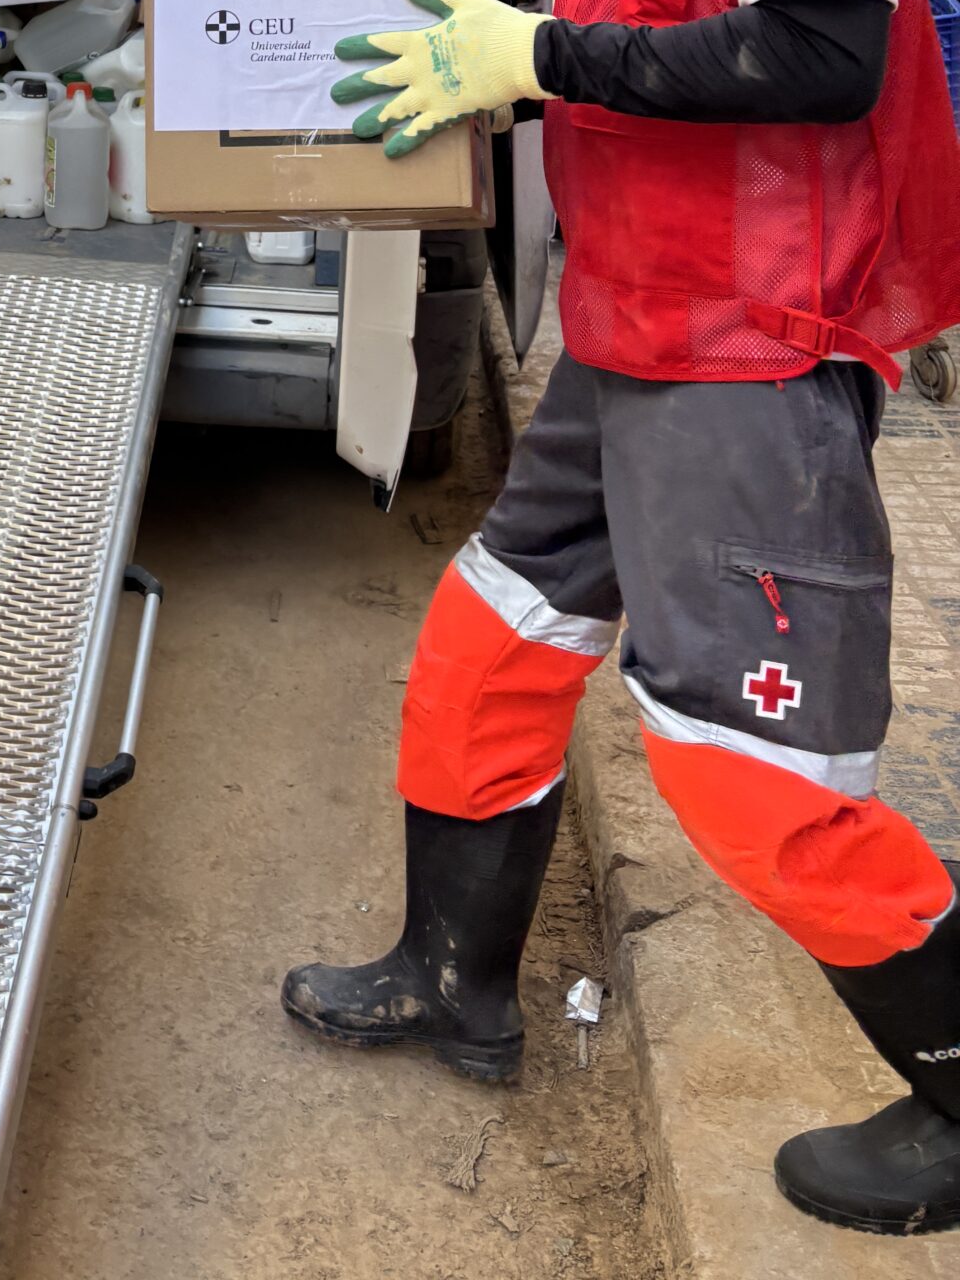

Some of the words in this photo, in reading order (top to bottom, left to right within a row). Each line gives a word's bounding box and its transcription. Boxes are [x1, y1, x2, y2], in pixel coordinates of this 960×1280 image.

[248, 17, 296, 36] CEU
[250, 40, 312, 51] Universidad
[250, 52, 296, 62] Cardenal
[298, 51, 336, 62] Herrera
